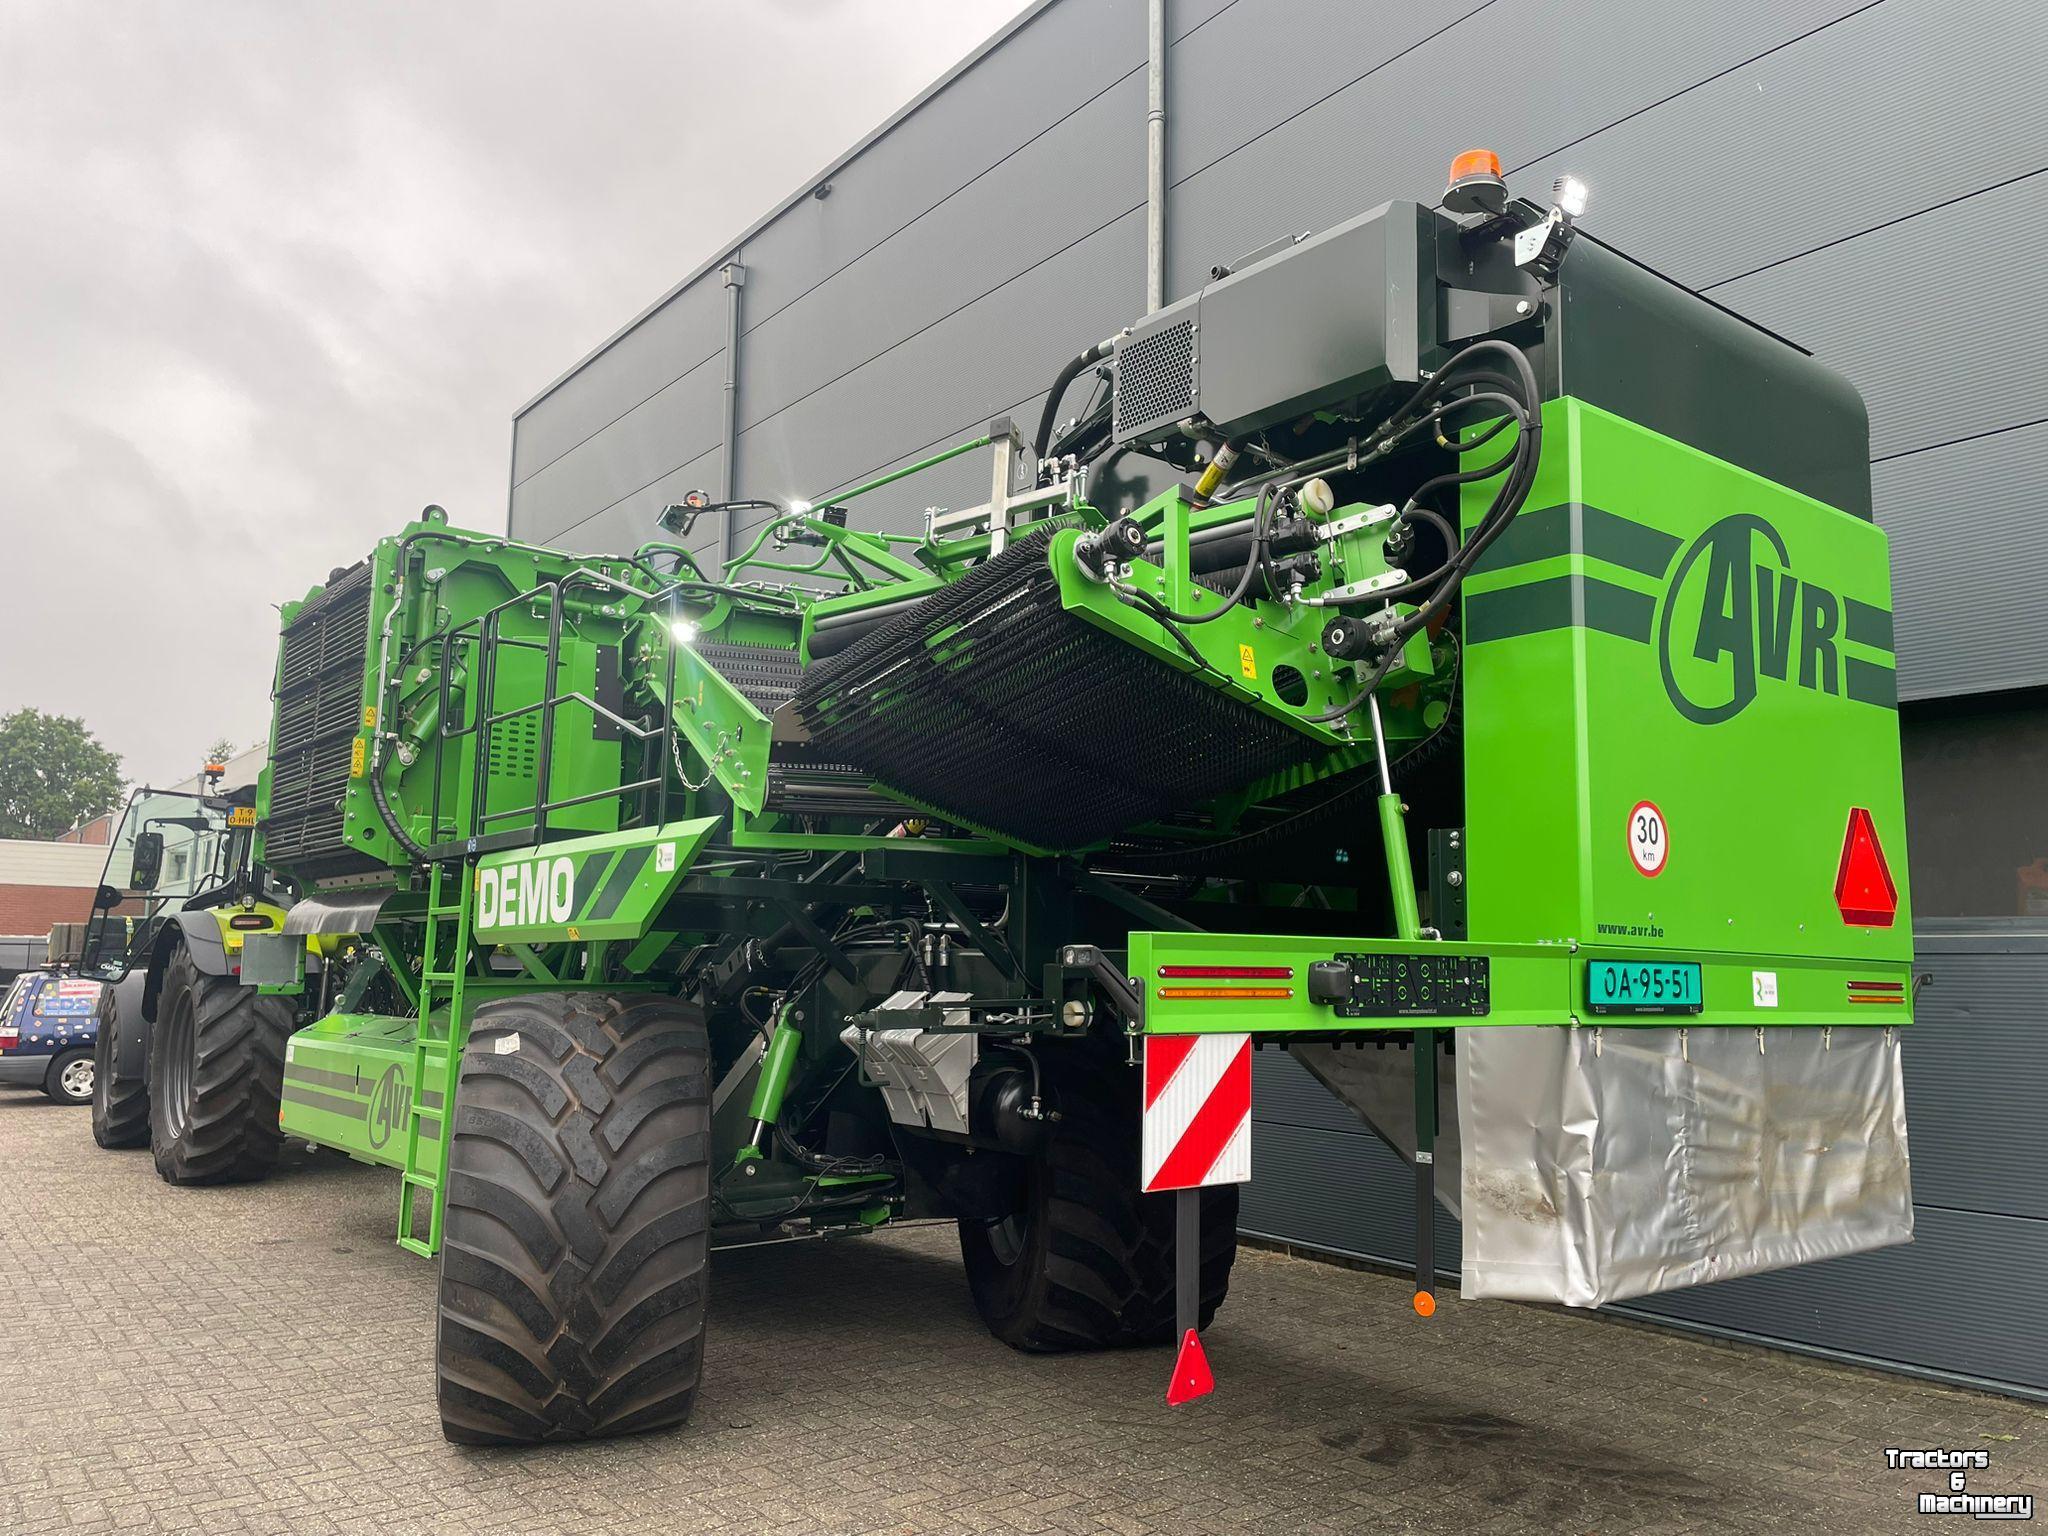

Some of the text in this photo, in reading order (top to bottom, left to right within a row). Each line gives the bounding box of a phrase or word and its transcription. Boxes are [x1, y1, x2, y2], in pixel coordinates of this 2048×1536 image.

[1658, 512, 1839, 726] AVR
[1637, 815, 1659, 846] 30
[1642, 849, 1656, 861] km
[478, 856, 575, 929] DEMO
[1597, 922, 1665, 938] www.avr.be
